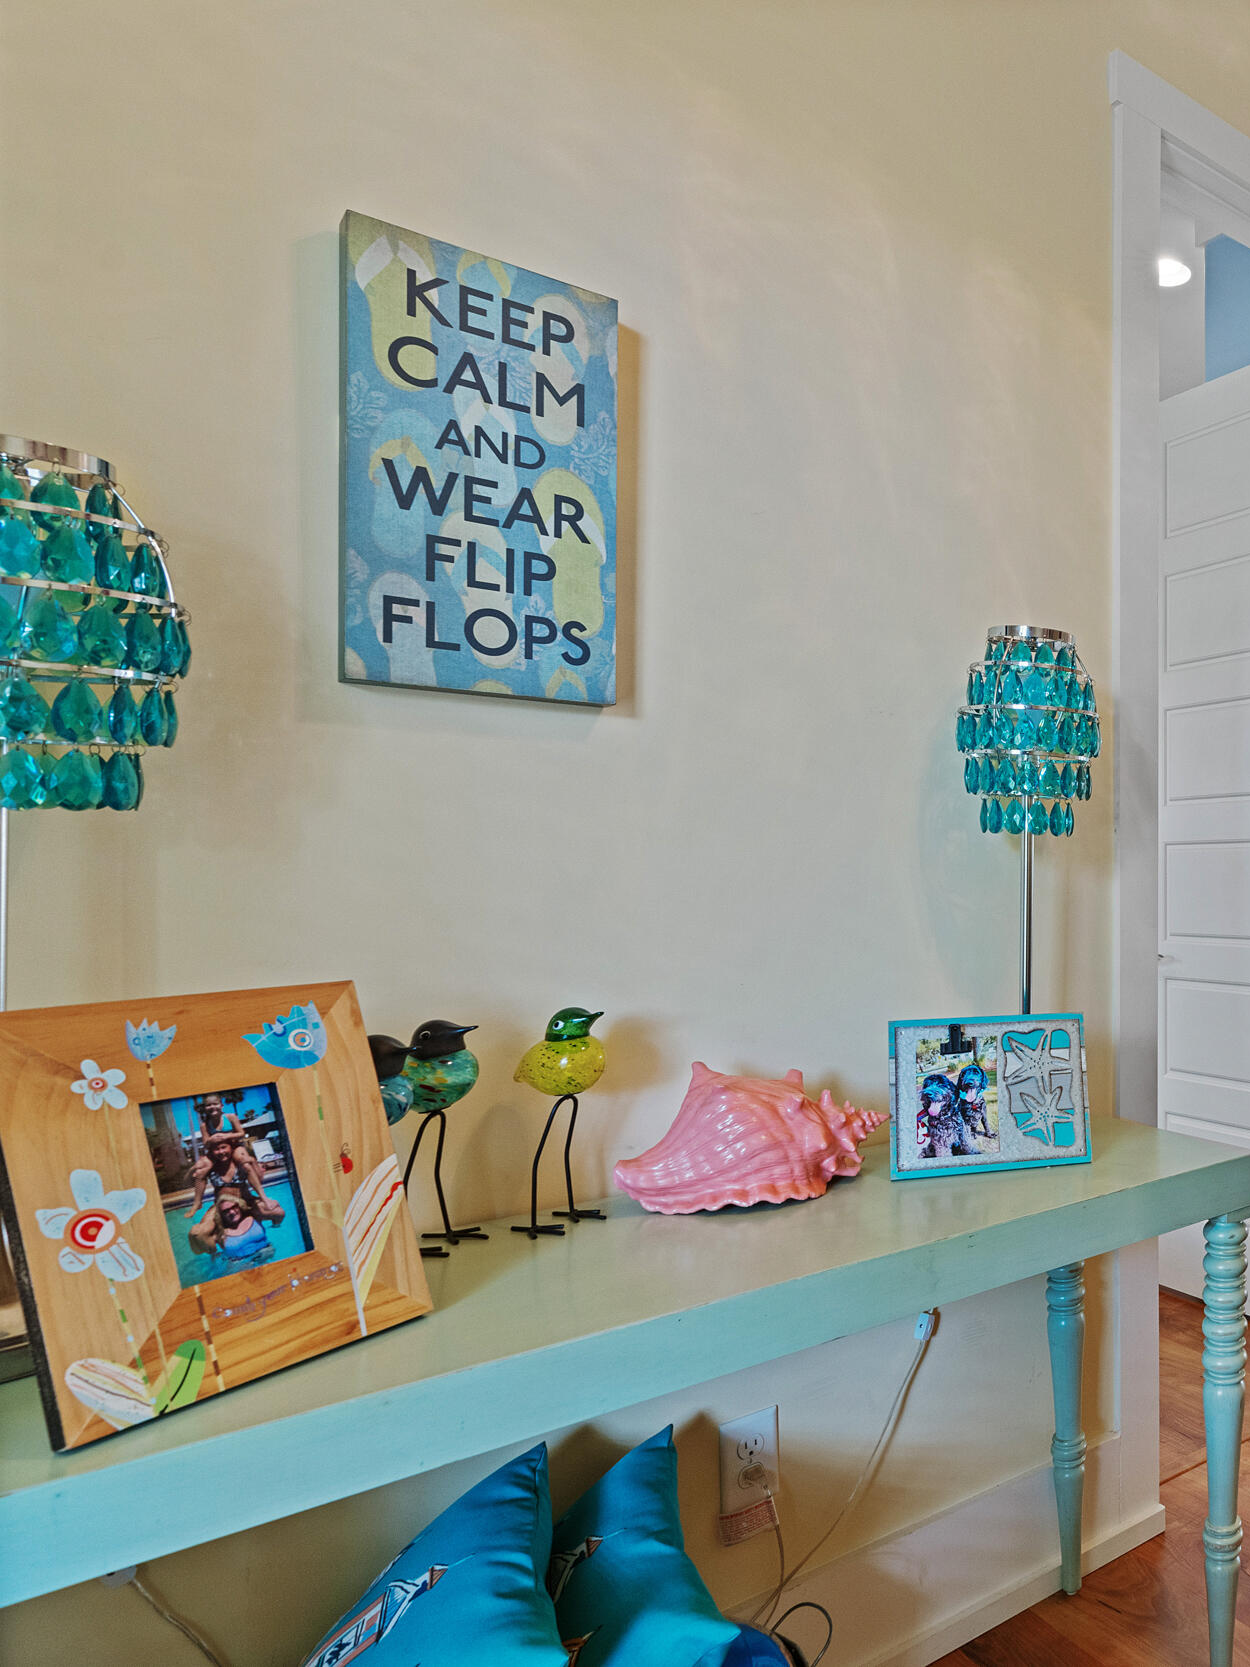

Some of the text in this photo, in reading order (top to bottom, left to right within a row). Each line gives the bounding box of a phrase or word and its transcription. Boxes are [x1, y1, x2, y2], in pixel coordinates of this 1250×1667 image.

[405, 267, 576, 357] KEEP
[387, 336, 586, 428] CALM
[434, 419, 547, 471] AND
[381, 458, 591, 544] WEAR
[425, 535, 557, 597] FLIP
[382, 595, 591, 667] FLOPS
